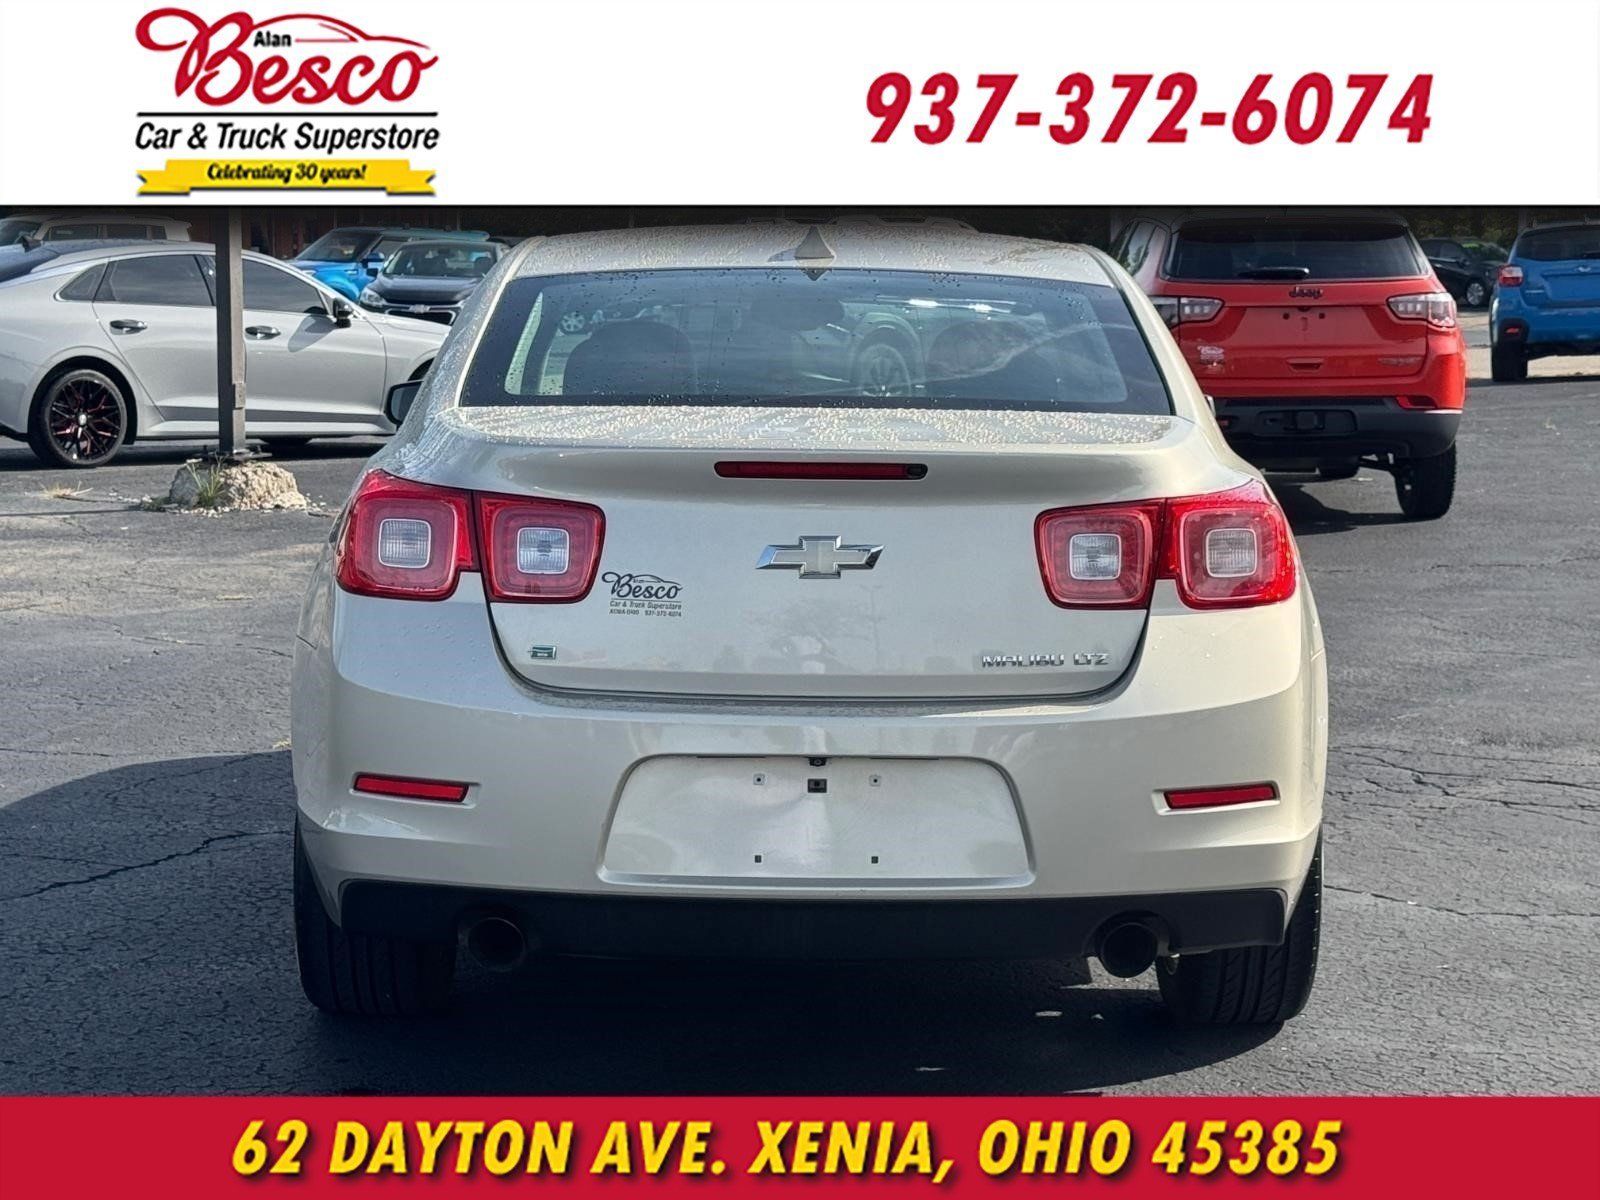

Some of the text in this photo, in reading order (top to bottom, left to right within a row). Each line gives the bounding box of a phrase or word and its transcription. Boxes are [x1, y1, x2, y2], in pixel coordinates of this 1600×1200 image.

[601, 571, 683, 599] Besco
[981, 652, 1109, 668] MALIBU LTZ
